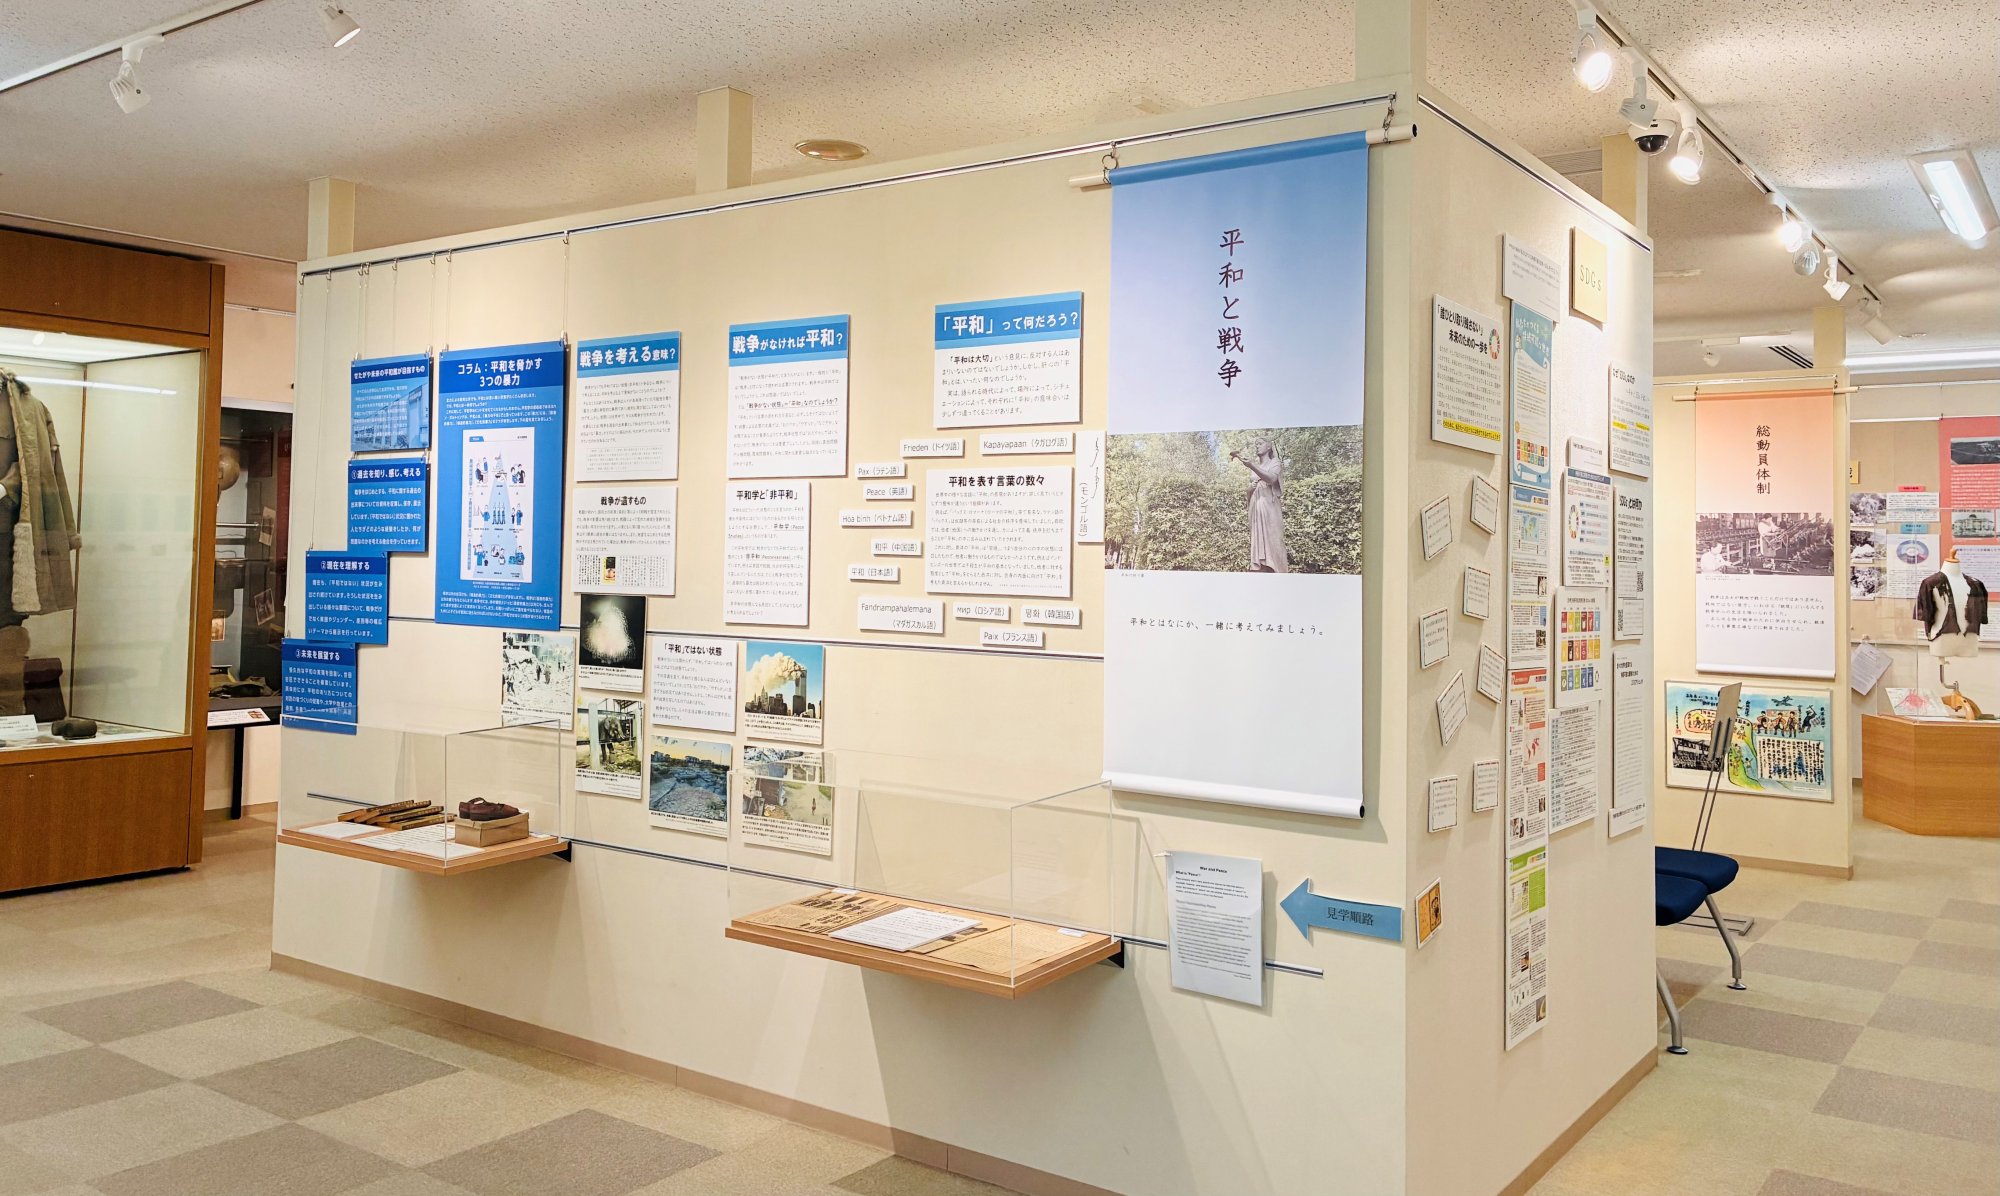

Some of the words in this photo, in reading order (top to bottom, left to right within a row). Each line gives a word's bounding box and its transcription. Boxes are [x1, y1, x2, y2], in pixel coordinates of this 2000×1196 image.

[1217, 228, 1245, 388] 平和と戦争
[732, 329, 843, 353] 戦争がなければ平和？
[580, 345, 676, 367] 戦争を考える意味？
[983, 440, 1027, 450] Kapayapaan
[1756, 425, 1771, 494] 総動員体制
[948, 474, 1045, 487] 平和を表す言葉の数々
[866, 488, 885, 496] Peace
[600, 496, 646, 506] 戦争が遺すもの
[1130, 617, 1324, 636] 平和とはなにか、一緒に考えてみましょう。
[984, 632, 998, 640] Paix
[664, 643, 722, 656] 「平和」ではない状態
[1327, 906, 1375, 926] 見学順路
